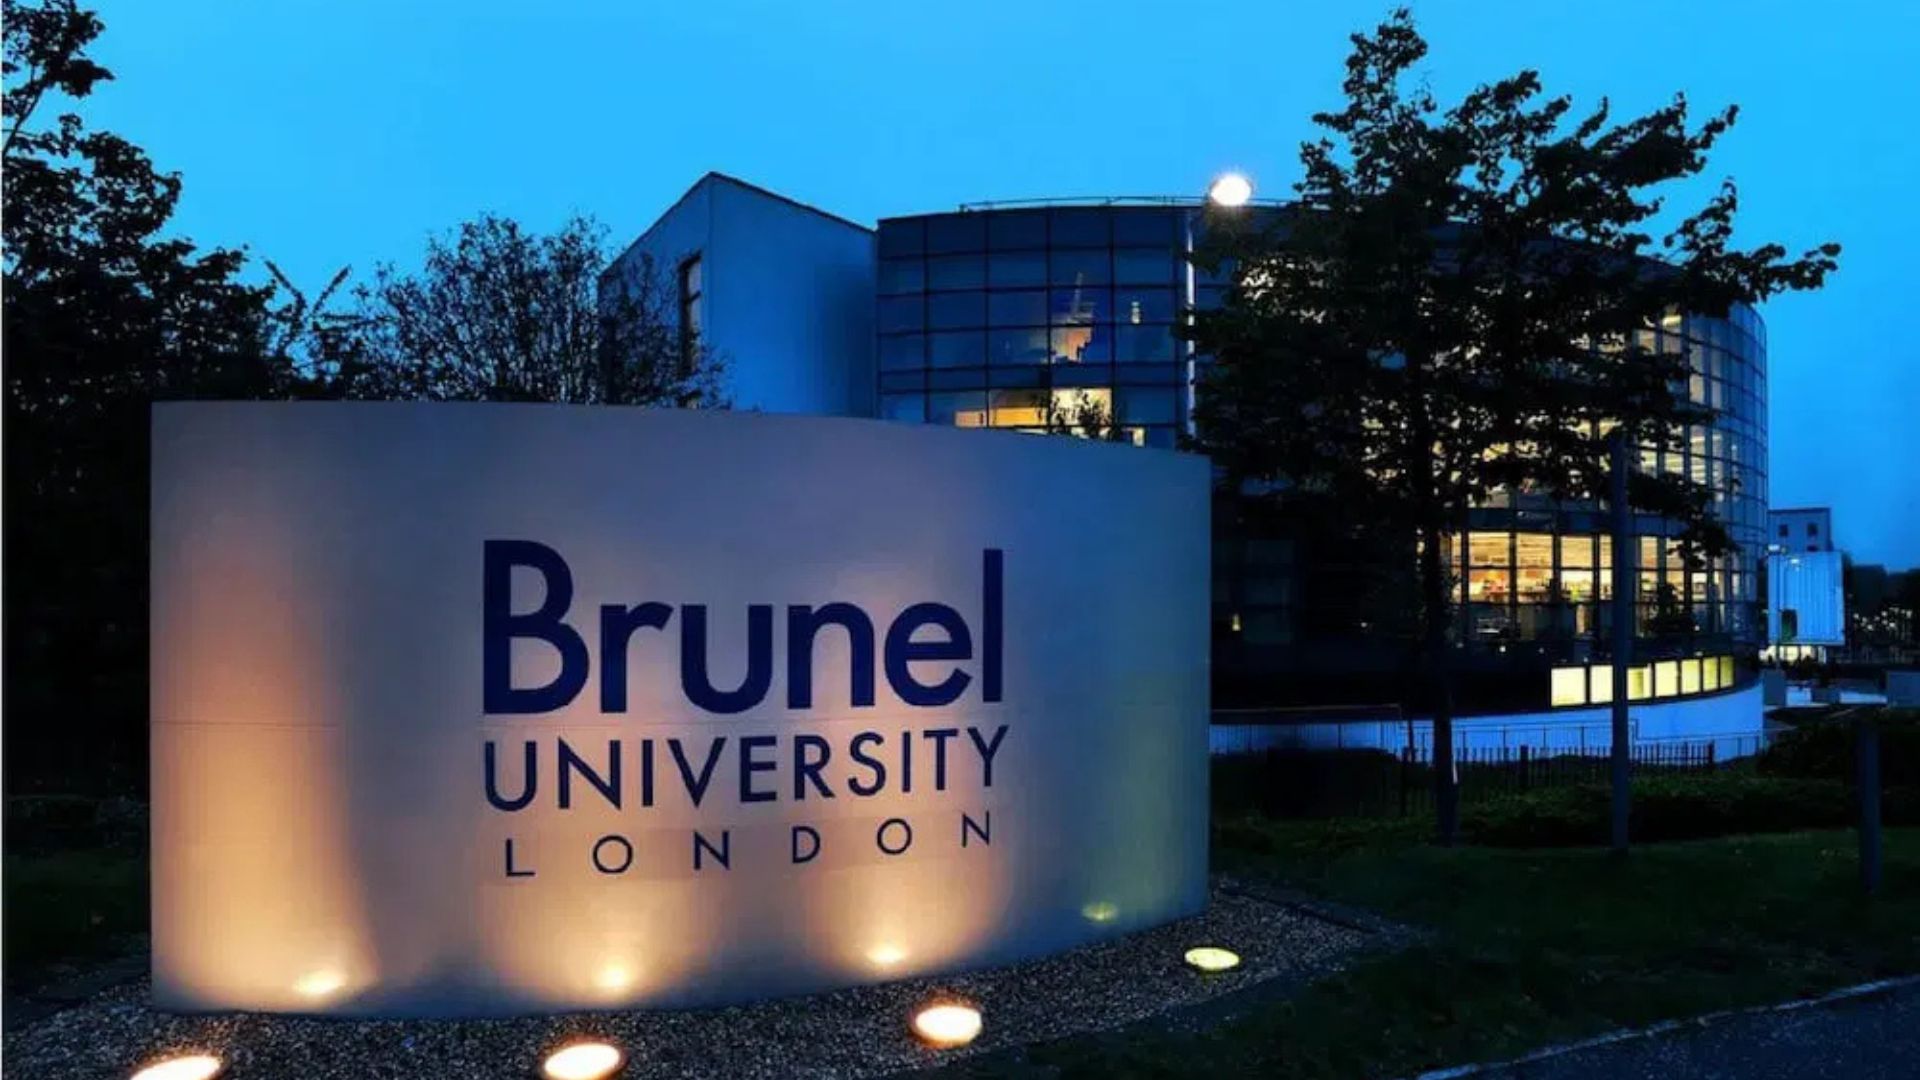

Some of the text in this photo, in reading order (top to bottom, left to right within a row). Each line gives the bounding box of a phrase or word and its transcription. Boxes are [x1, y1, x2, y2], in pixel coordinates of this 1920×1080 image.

[483, 539, 1004, 714] Brunel
[484, 725, 1008, 811] UNIVERSITY
[505, 811, 991, 877] LONDON
